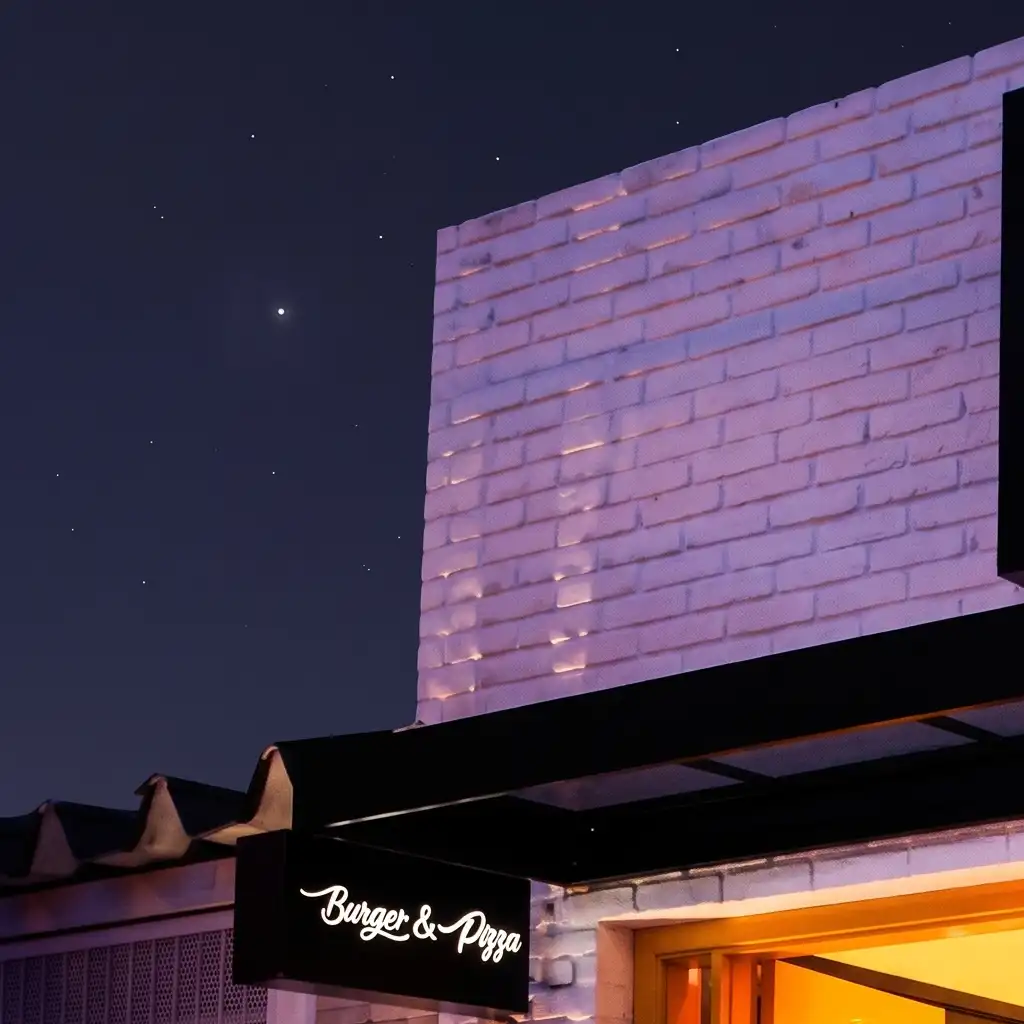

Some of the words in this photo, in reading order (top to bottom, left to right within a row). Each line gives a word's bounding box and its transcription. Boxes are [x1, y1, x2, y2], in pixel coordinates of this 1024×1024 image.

[299, 885, 411, 942] Burger
[412, 904, 438, 941] &
[437, 910, 523, 964] Pizza
